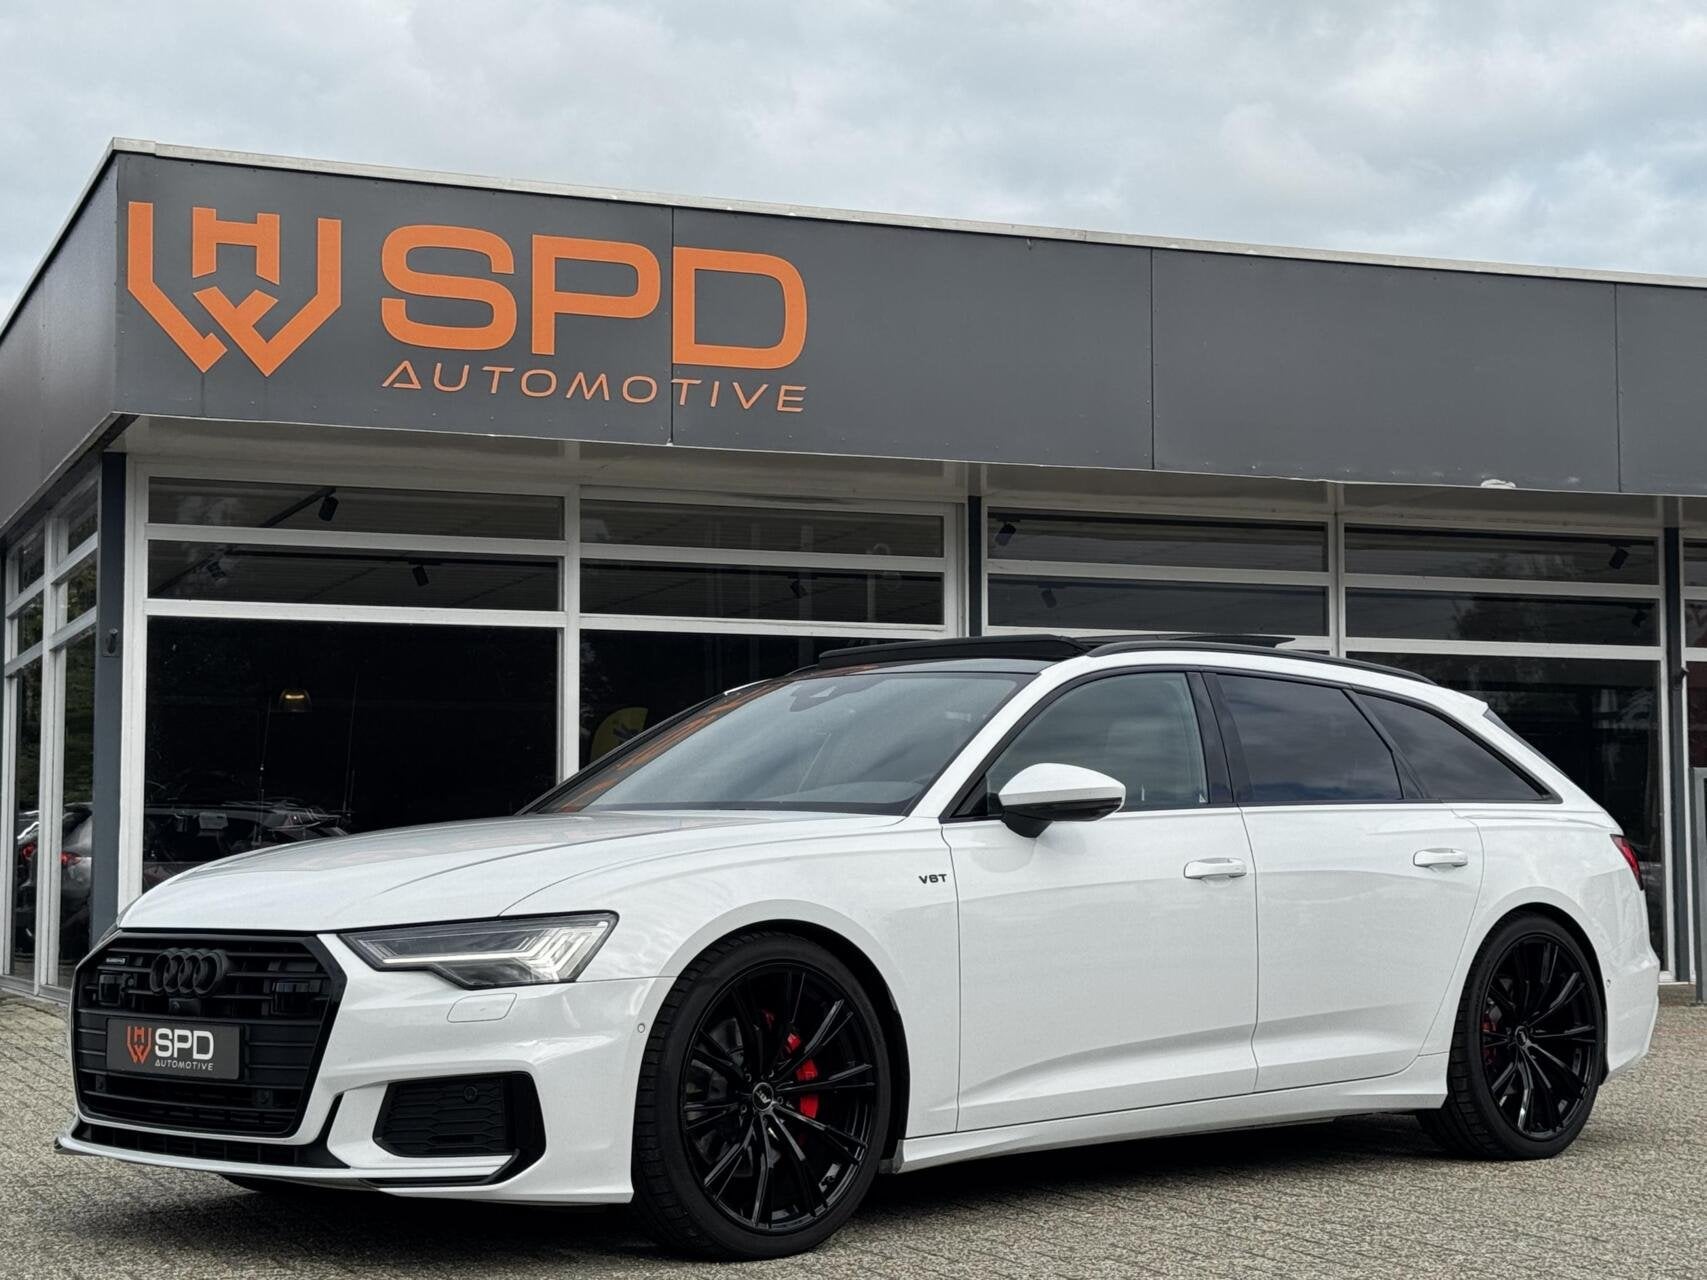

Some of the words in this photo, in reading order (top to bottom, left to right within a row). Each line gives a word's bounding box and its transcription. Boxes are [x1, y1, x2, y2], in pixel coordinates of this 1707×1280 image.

[381, 224, 808, 369] SPD
[382, 360, 808, 413] AUTOMOTIVE
[154, 1028, 214, 1060] SPD
[154, 1058, 214, 1071] AUTOMOTIVE
